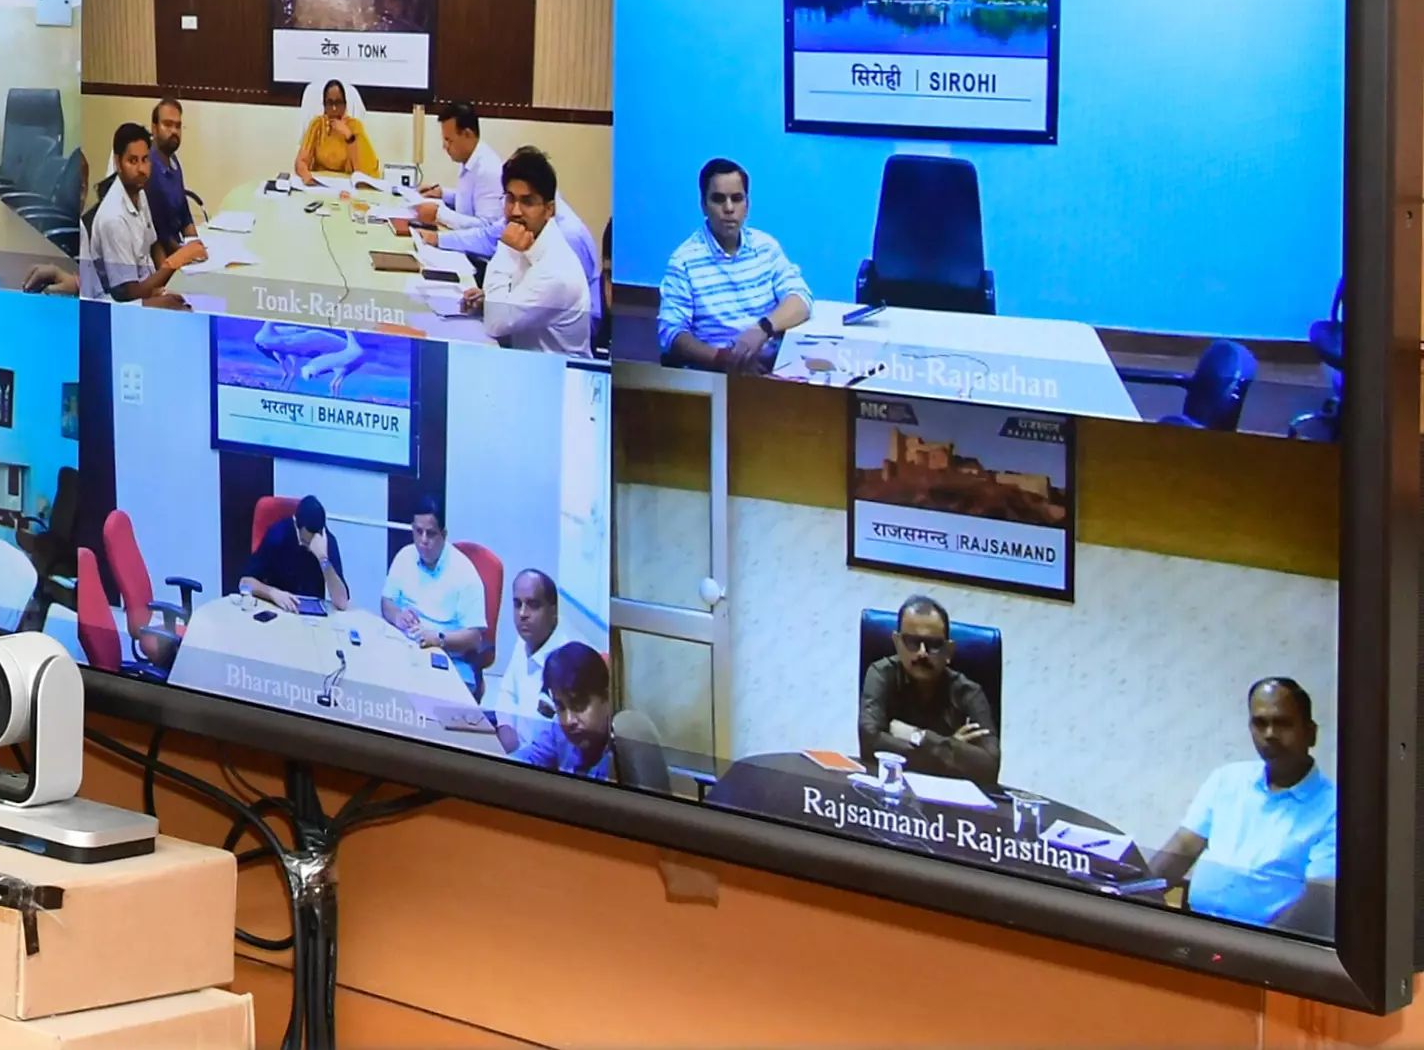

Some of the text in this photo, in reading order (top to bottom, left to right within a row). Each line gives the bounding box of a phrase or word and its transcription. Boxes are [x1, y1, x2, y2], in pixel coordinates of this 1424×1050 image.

[320, 38, 340, 56] टोंक
[358, 44, 387, 58] TONK
[851, 63, 901, 90] सिरोही
[929, 71, 997, 93] SIROHI
[253, 286, 406, 326] Tonk-Rajasthan
[260, 398, 304, 422] भरतपुर
[318, 406, 399, 432] BHARATPUR
[860, 402, 888, 417] NIC
[960, 535, 1056, 563] RAJSAMAND
[226, 663, 427, 729] Bharatpur-Rajasthan
[803, 786, 1091, 874] Rajsamand-Rajasthan
